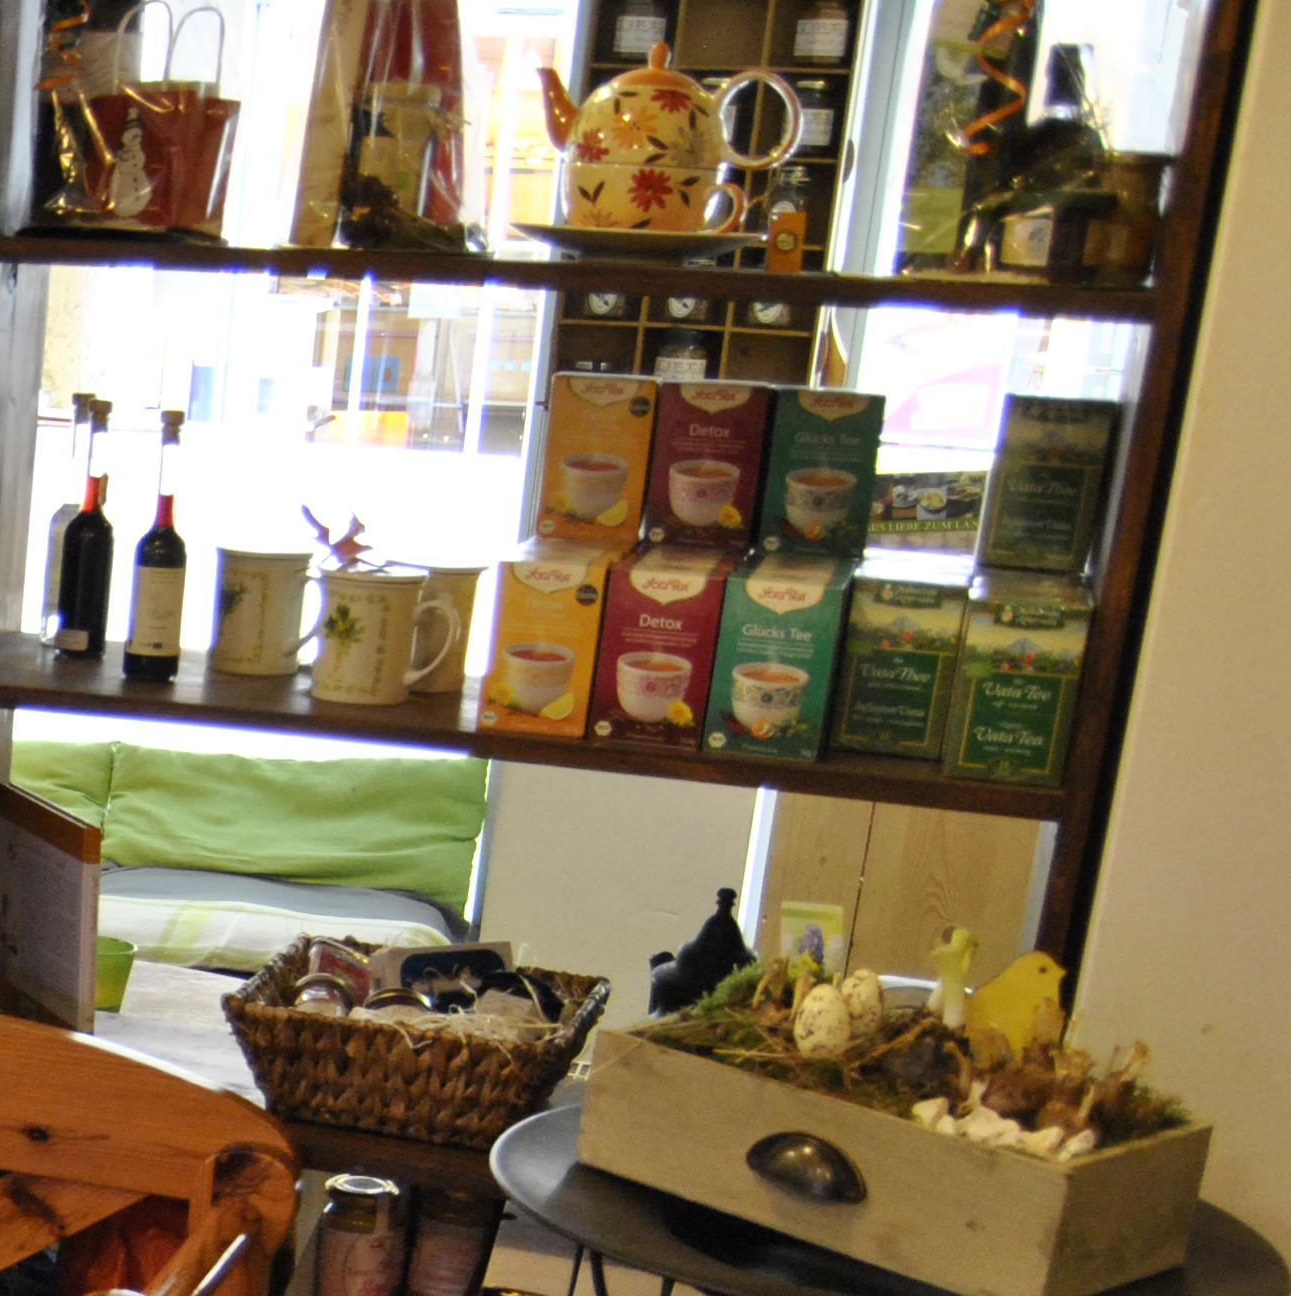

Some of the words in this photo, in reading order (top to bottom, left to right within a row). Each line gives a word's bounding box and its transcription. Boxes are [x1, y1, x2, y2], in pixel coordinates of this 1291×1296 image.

[689, 424, 730, 438] Detox
[924, 519, 951, 531] ZUM
[639, 613, 684, 631] Detox
[790, 627, 813, 642] Tee
